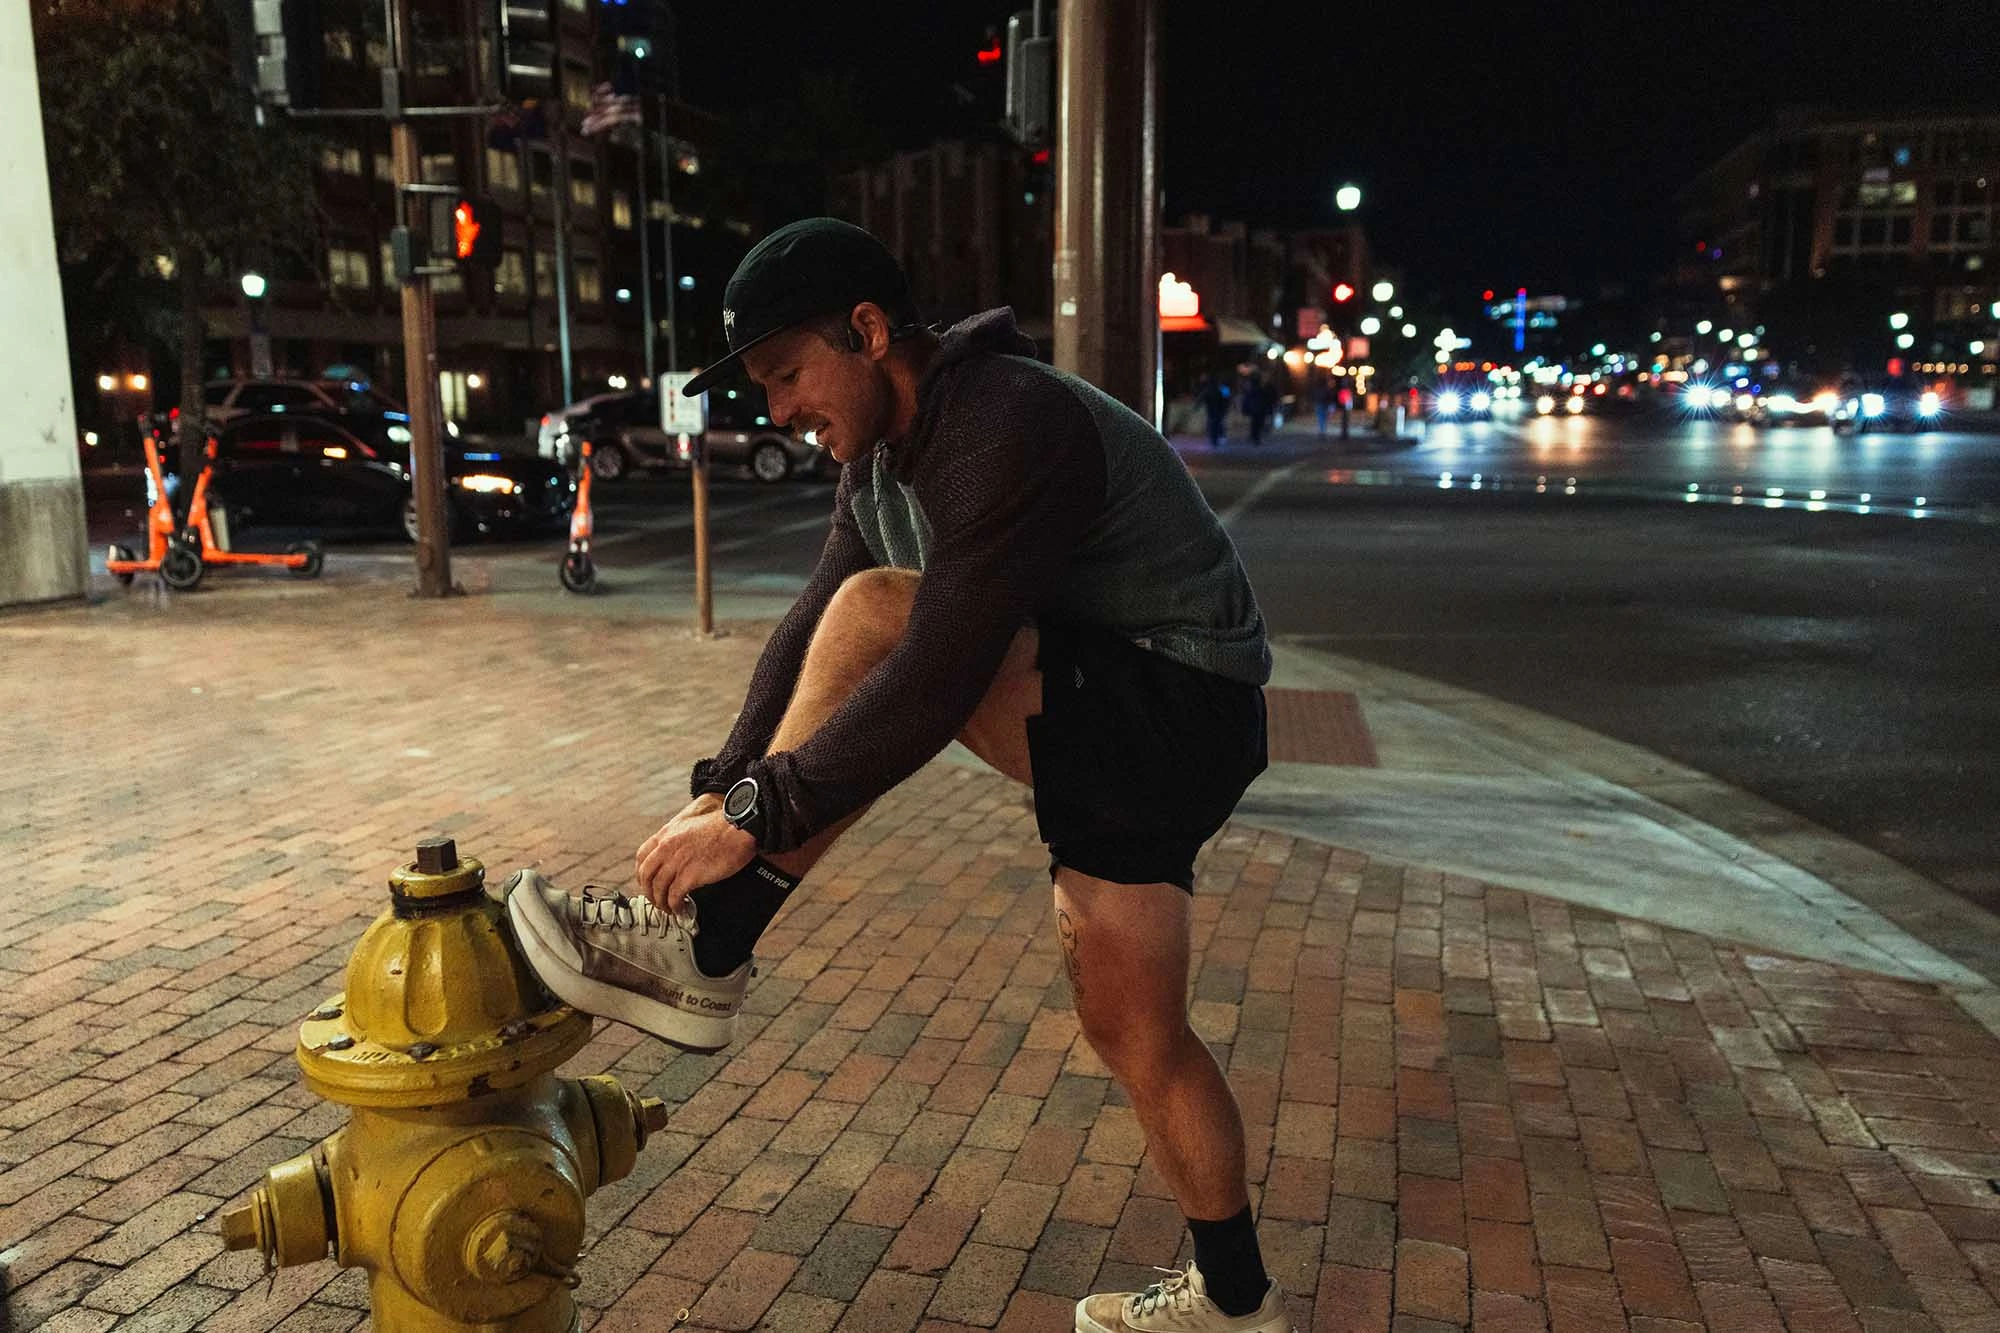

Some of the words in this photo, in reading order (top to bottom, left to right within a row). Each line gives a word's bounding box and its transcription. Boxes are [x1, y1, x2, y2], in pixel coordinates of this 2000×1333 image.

[756, 866, 776, 882] EAST
[686, 994, 698, 1006] to
[700, 997, 732, 1011] Coast
